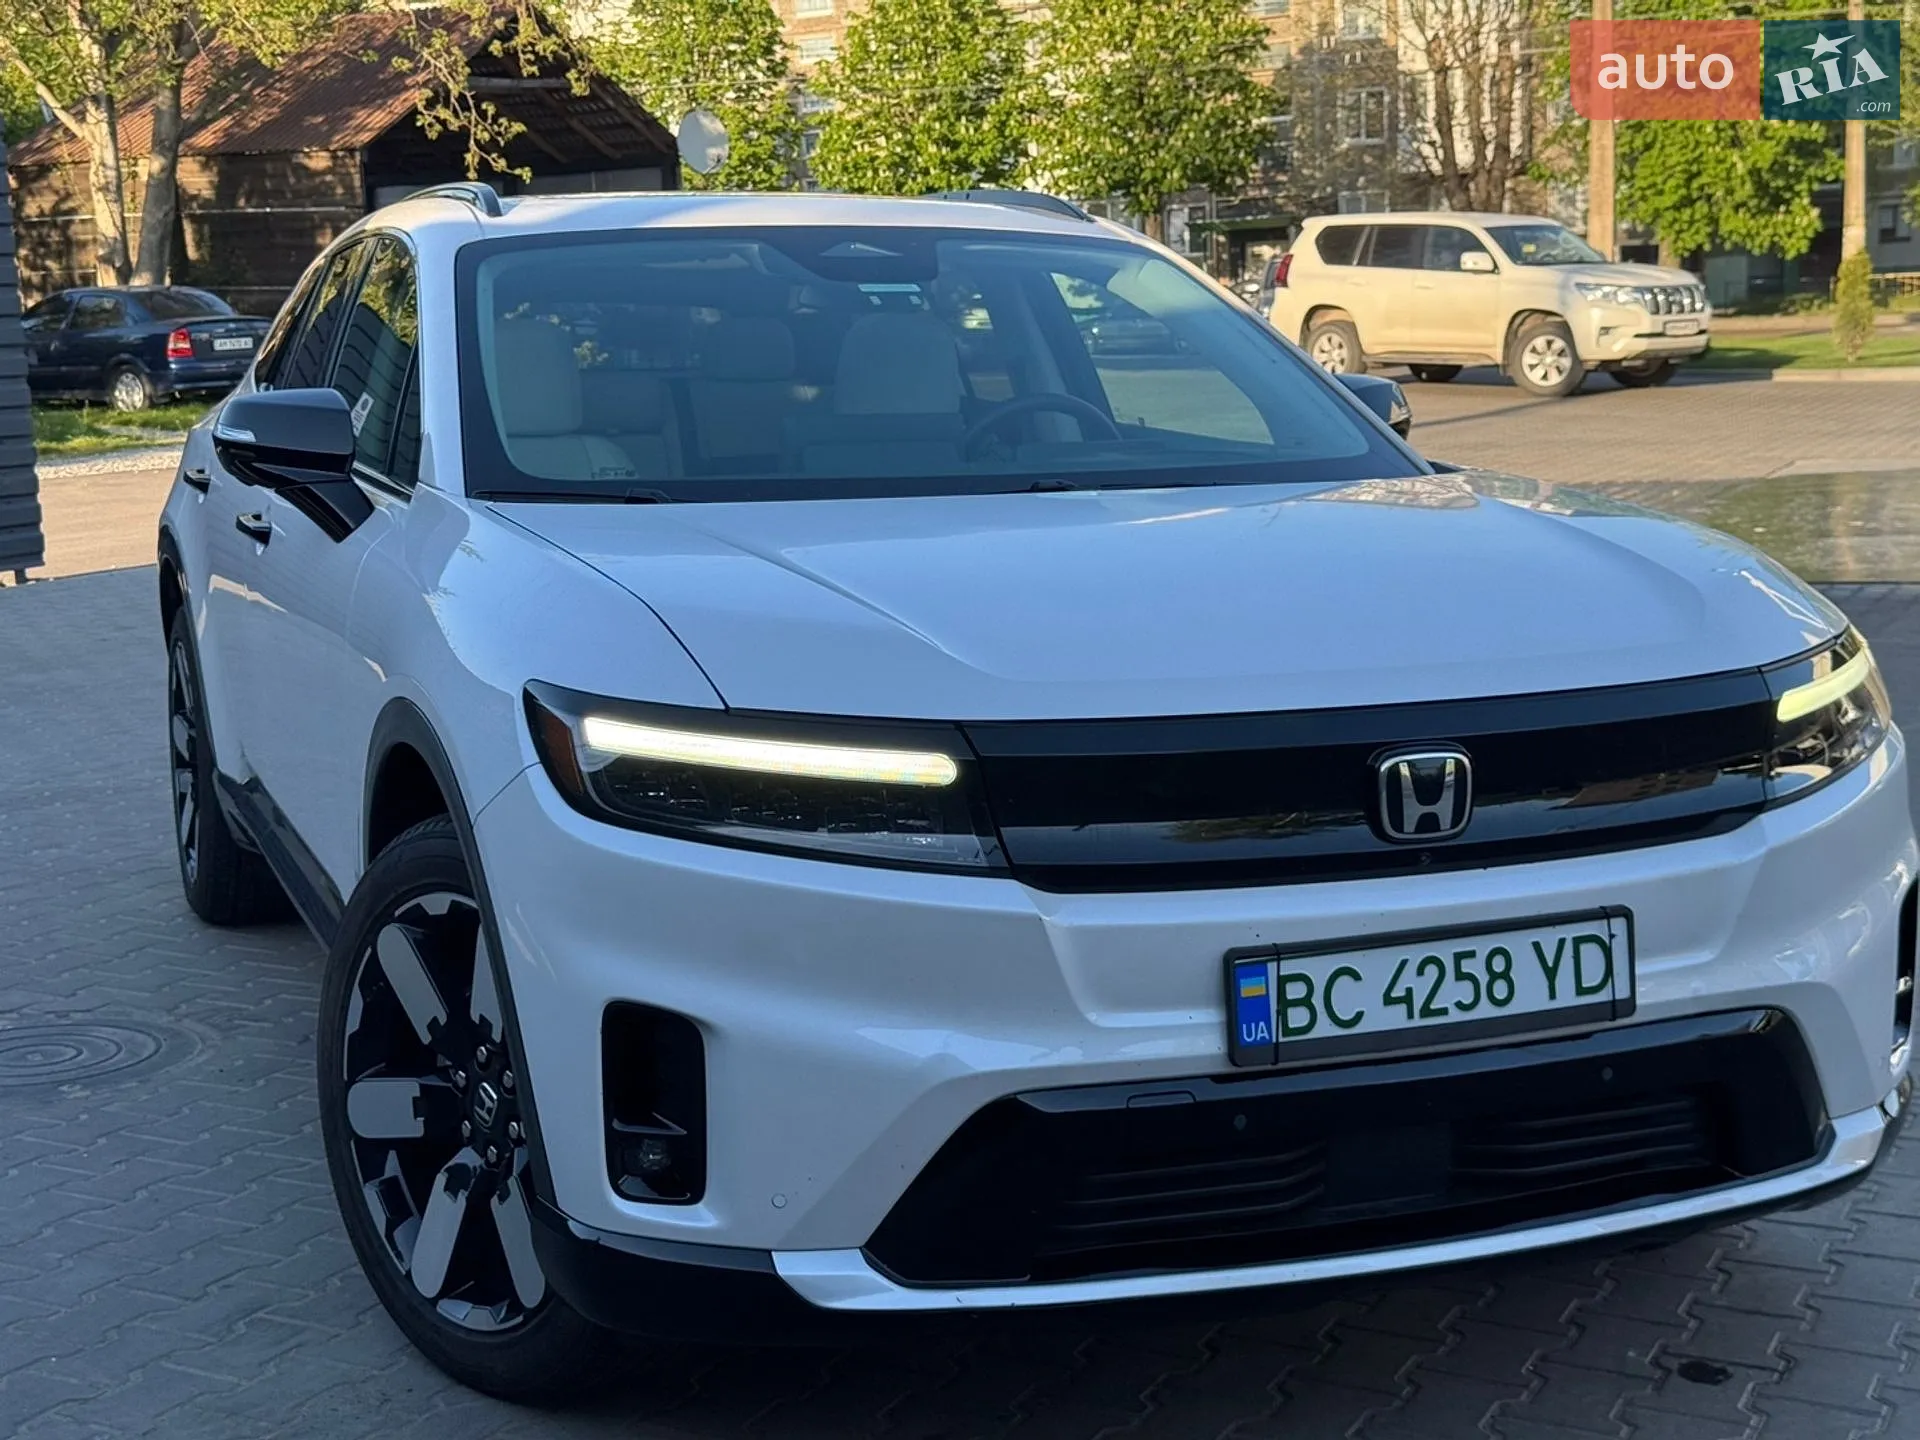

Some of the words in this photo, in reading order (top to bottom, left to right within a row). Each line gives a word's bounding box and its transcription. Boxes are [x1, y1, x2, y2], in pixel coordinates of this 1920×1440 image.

[1279, 965, 1365, 1038] BC
[1382, 945, 1516, 1020] 4258
[1531, 933, 1612, 1000] YD
[1242, 1021, 1270, 1042] UA
